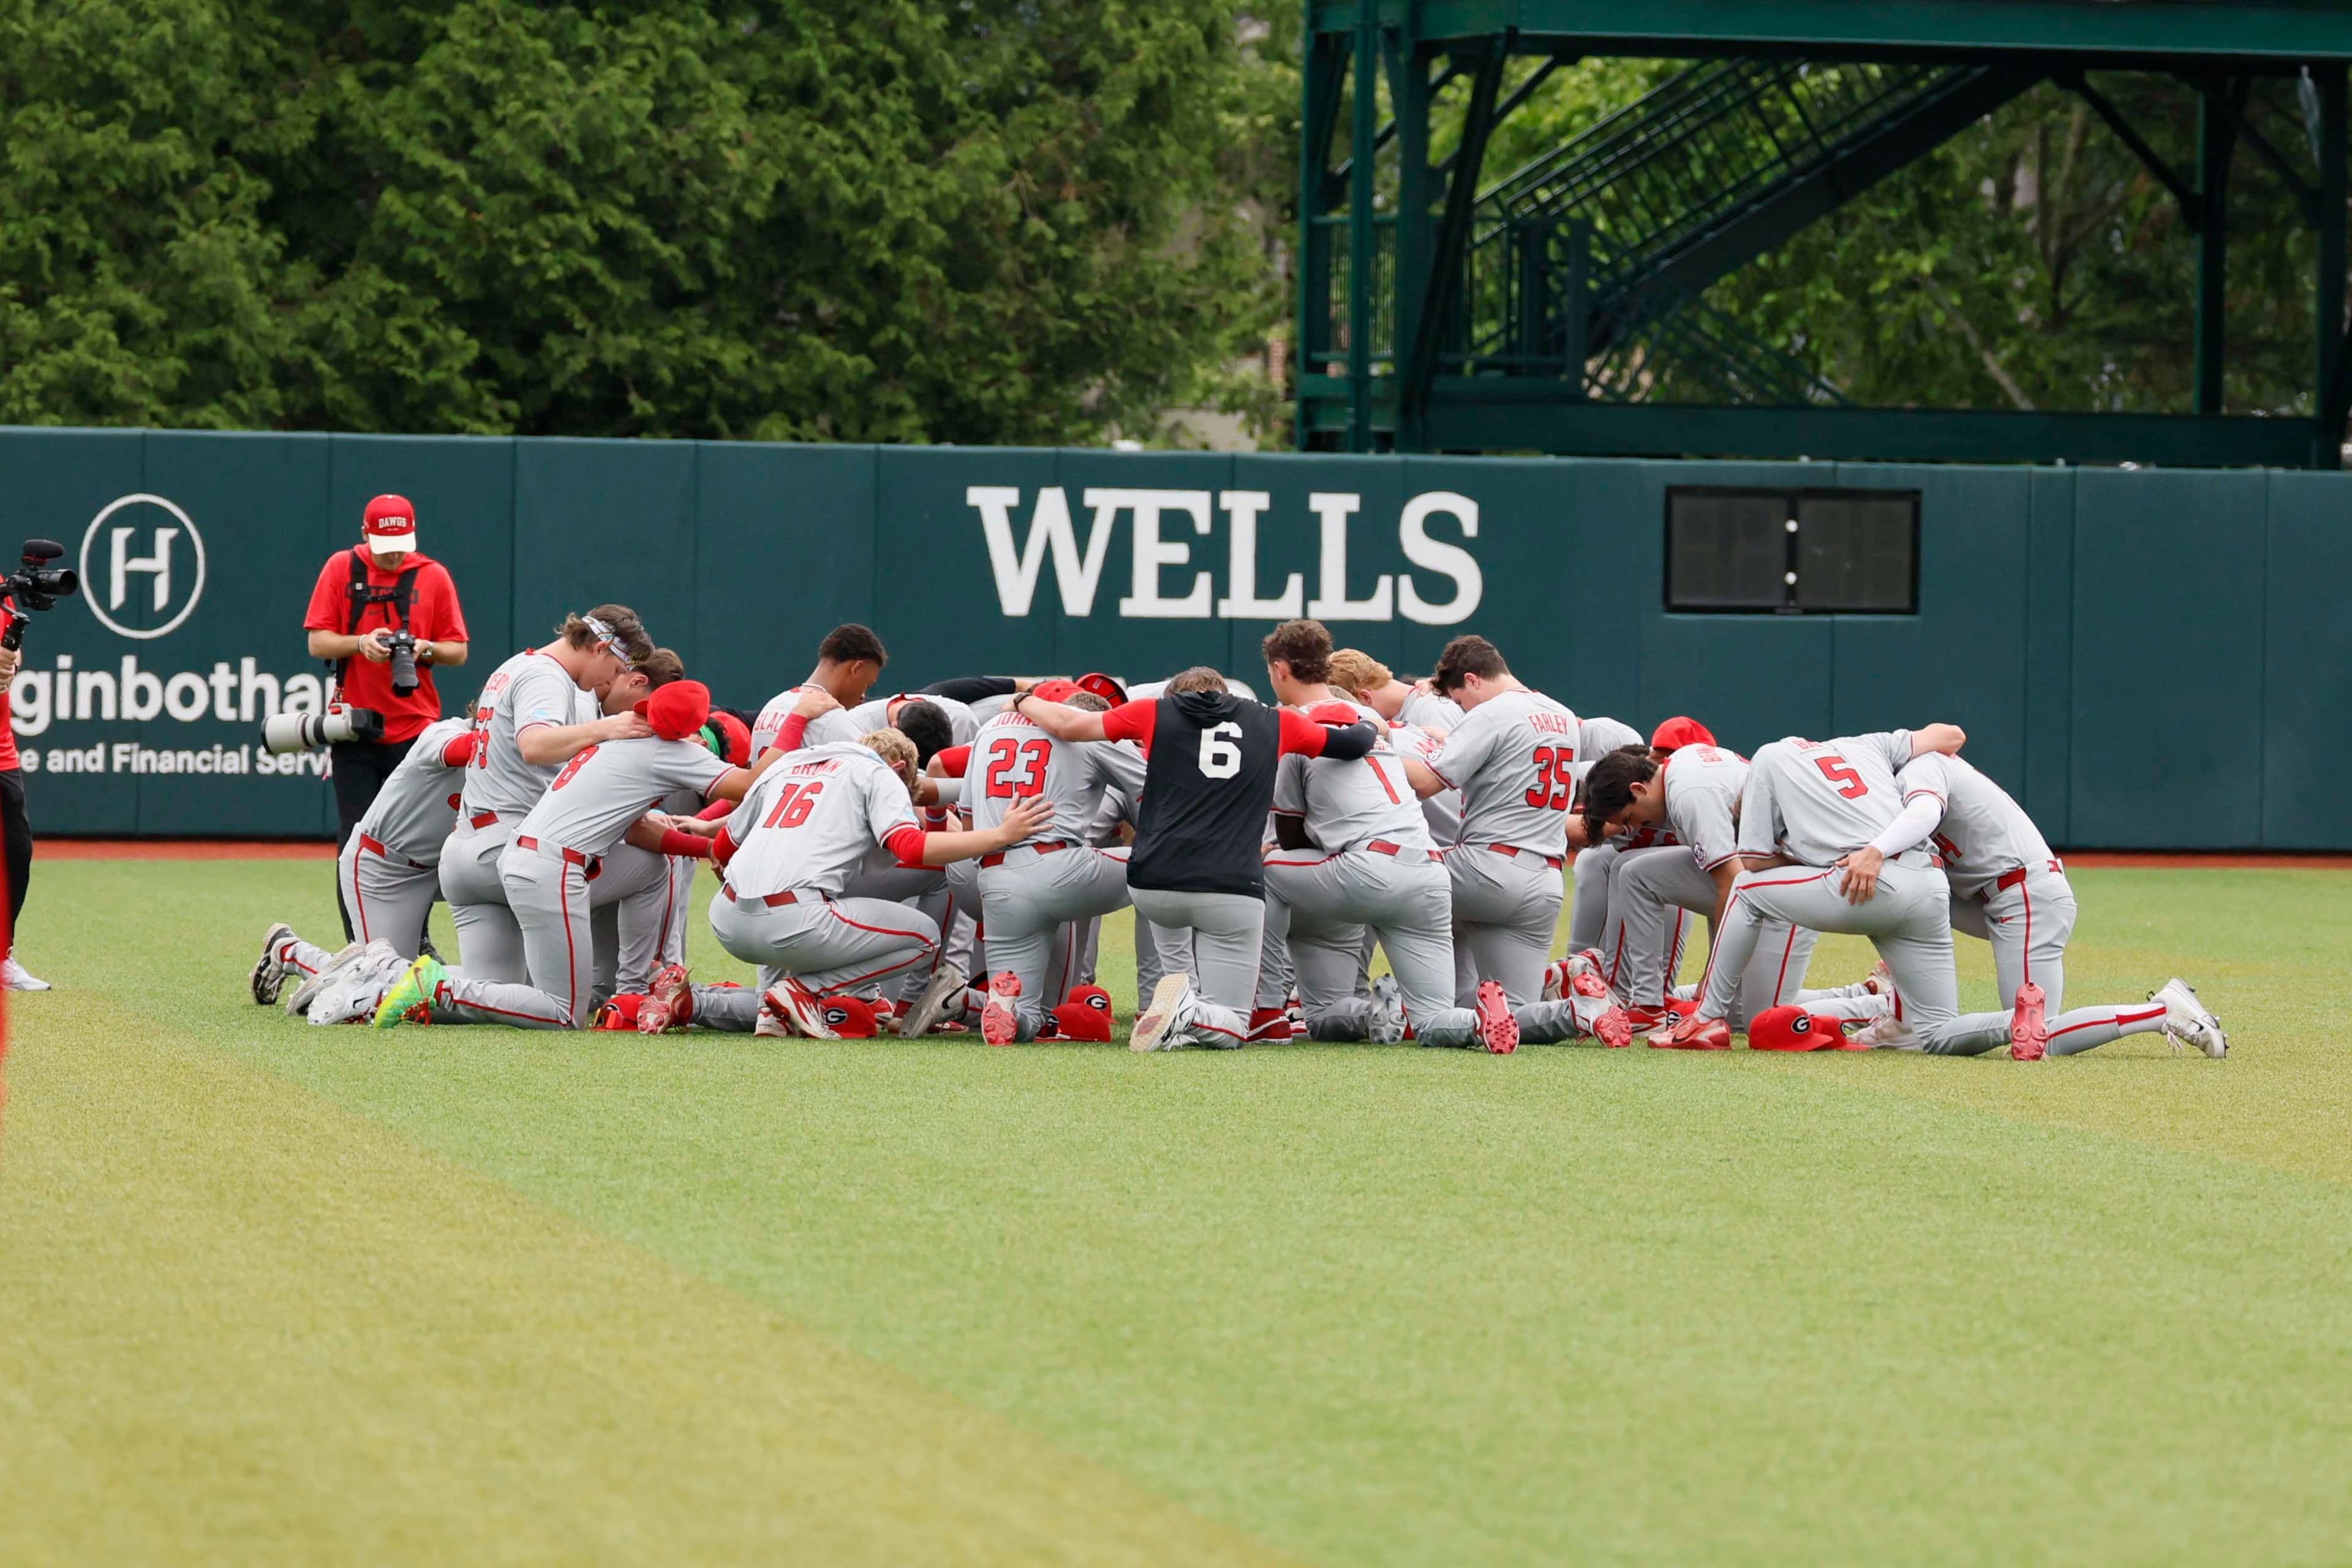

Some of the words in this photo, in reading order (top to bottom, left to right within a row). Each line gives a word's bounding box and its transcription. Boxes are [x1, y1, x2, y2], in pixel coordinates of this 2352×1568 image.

[379, 516, 407, 529] DAWGS
[110, 527, 180, 612] H
[967, 487, 1483, 625] WELLS
[9, 655, 336, 736] ginbotha
[992, 712, 1039, 727] JOHN
[1529, 713, 1568, 735] FARLEY
[47, 742, 104, 772] and
[113, 743, 249, 774] Financial
[552, 745, 600, 791] 8
[986, 739, 1052, 799] 23
[1199, 721, 1243, 779] 6
[1364, 756, 1401, 804] 1
[1525, 746, 1574, 811] 35
[1814, 756, 1869, 799] 5
[763, 782, 824, 829] 16
